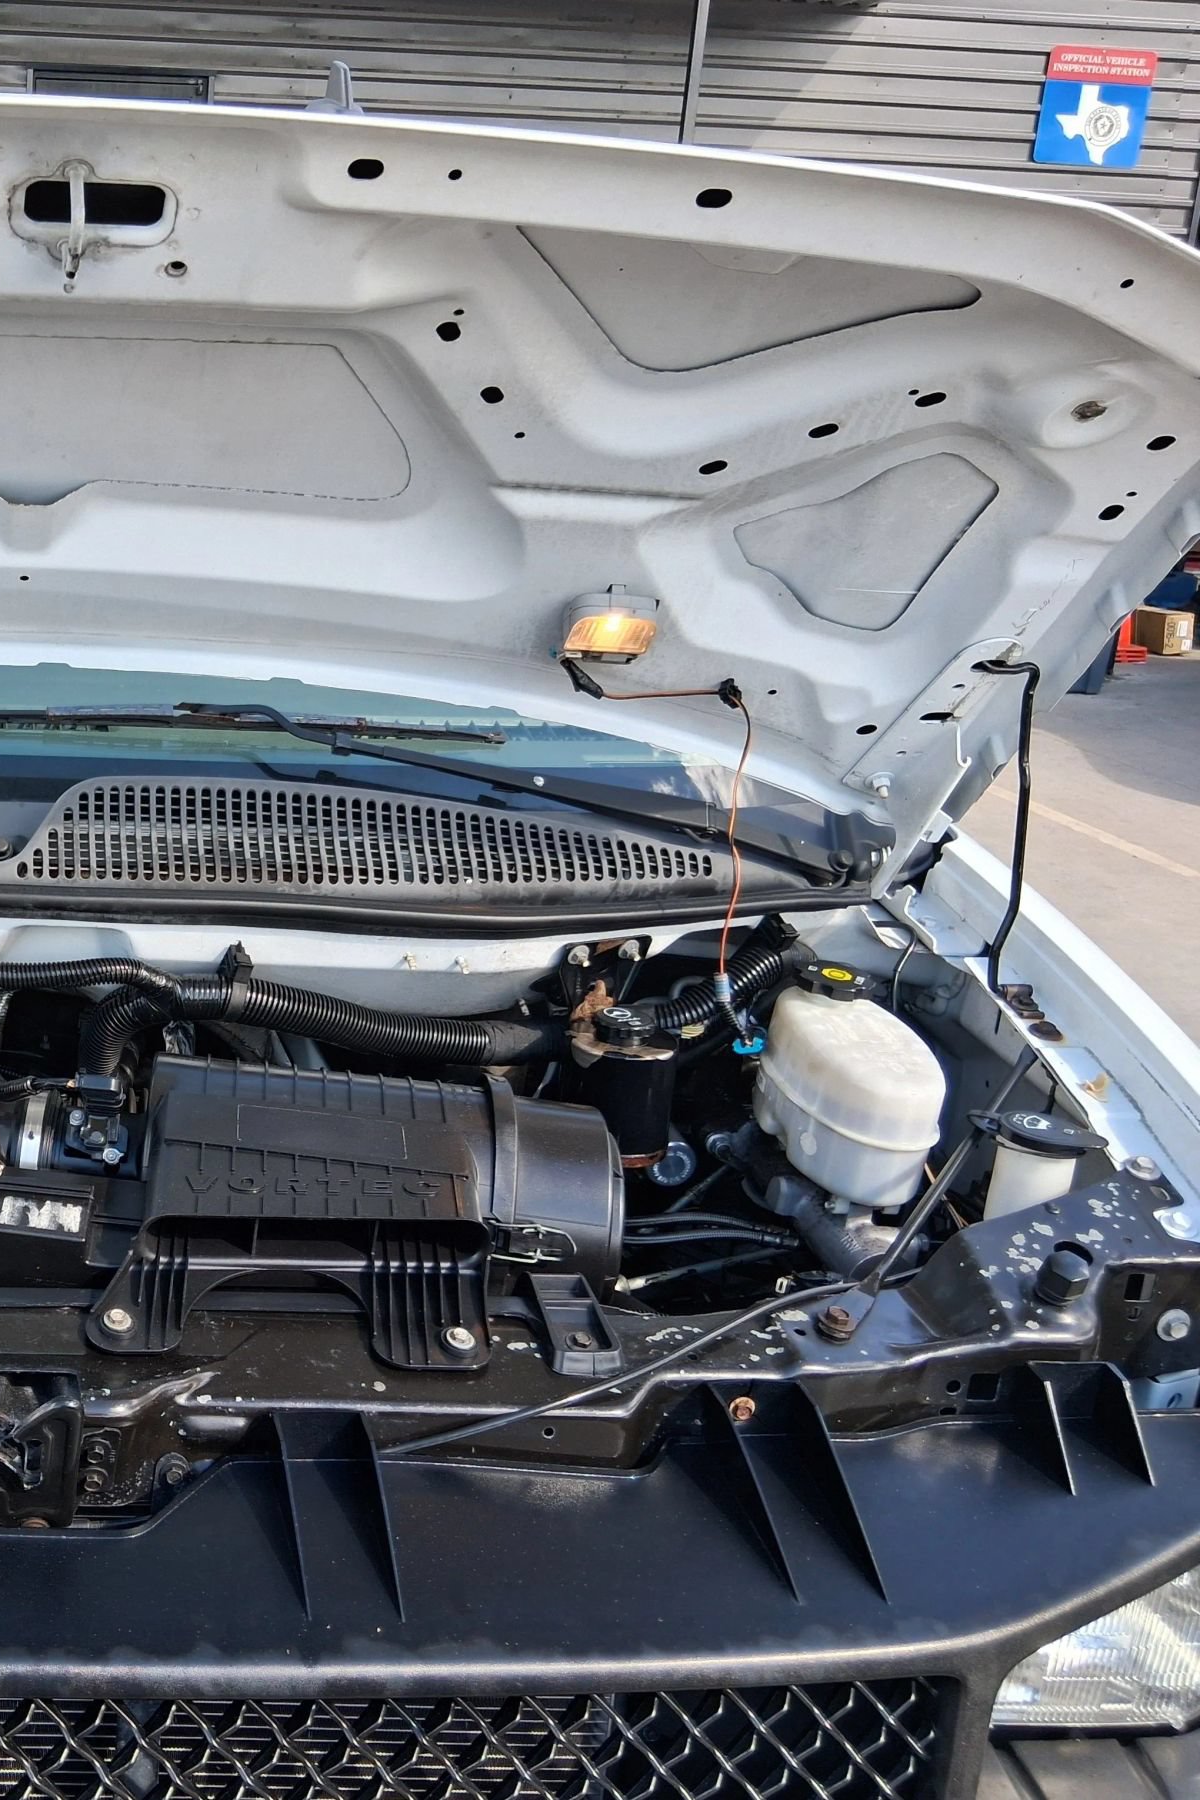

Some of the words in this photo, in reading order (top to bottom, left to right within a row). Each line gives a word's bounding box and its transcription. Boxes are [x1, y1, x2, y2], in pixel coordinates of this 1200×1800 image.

[1061, 53, 1104, 64] OFFICIAL
[1105, 56, 1147, 66] VEHICLE
[1053, 62, 1109, 74] INSPECTION
[1110, 66, 1151, 77] STATION
[185, 1175, 441, 1198] VORTEC
